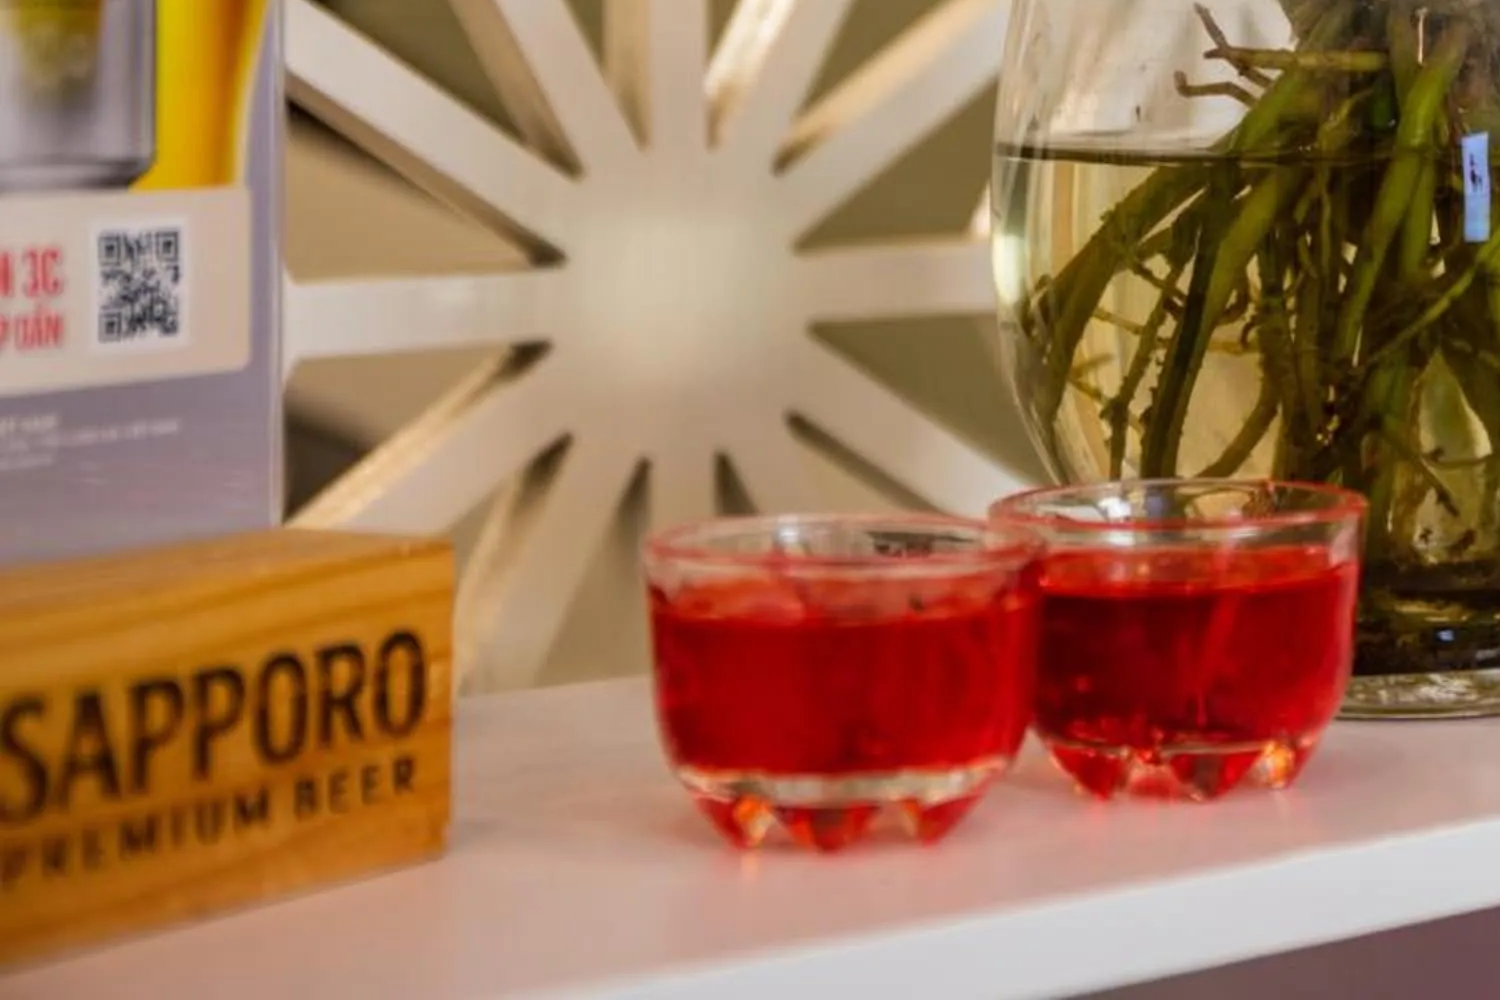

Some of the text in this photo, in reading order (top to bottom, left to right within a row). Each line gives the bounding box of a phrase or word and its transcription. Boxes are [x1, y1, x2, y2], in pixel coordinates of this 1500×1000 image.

[0, 628, 428, 824] SAPPORO
[0, 755, 415, 889] PREMIUM BEER
